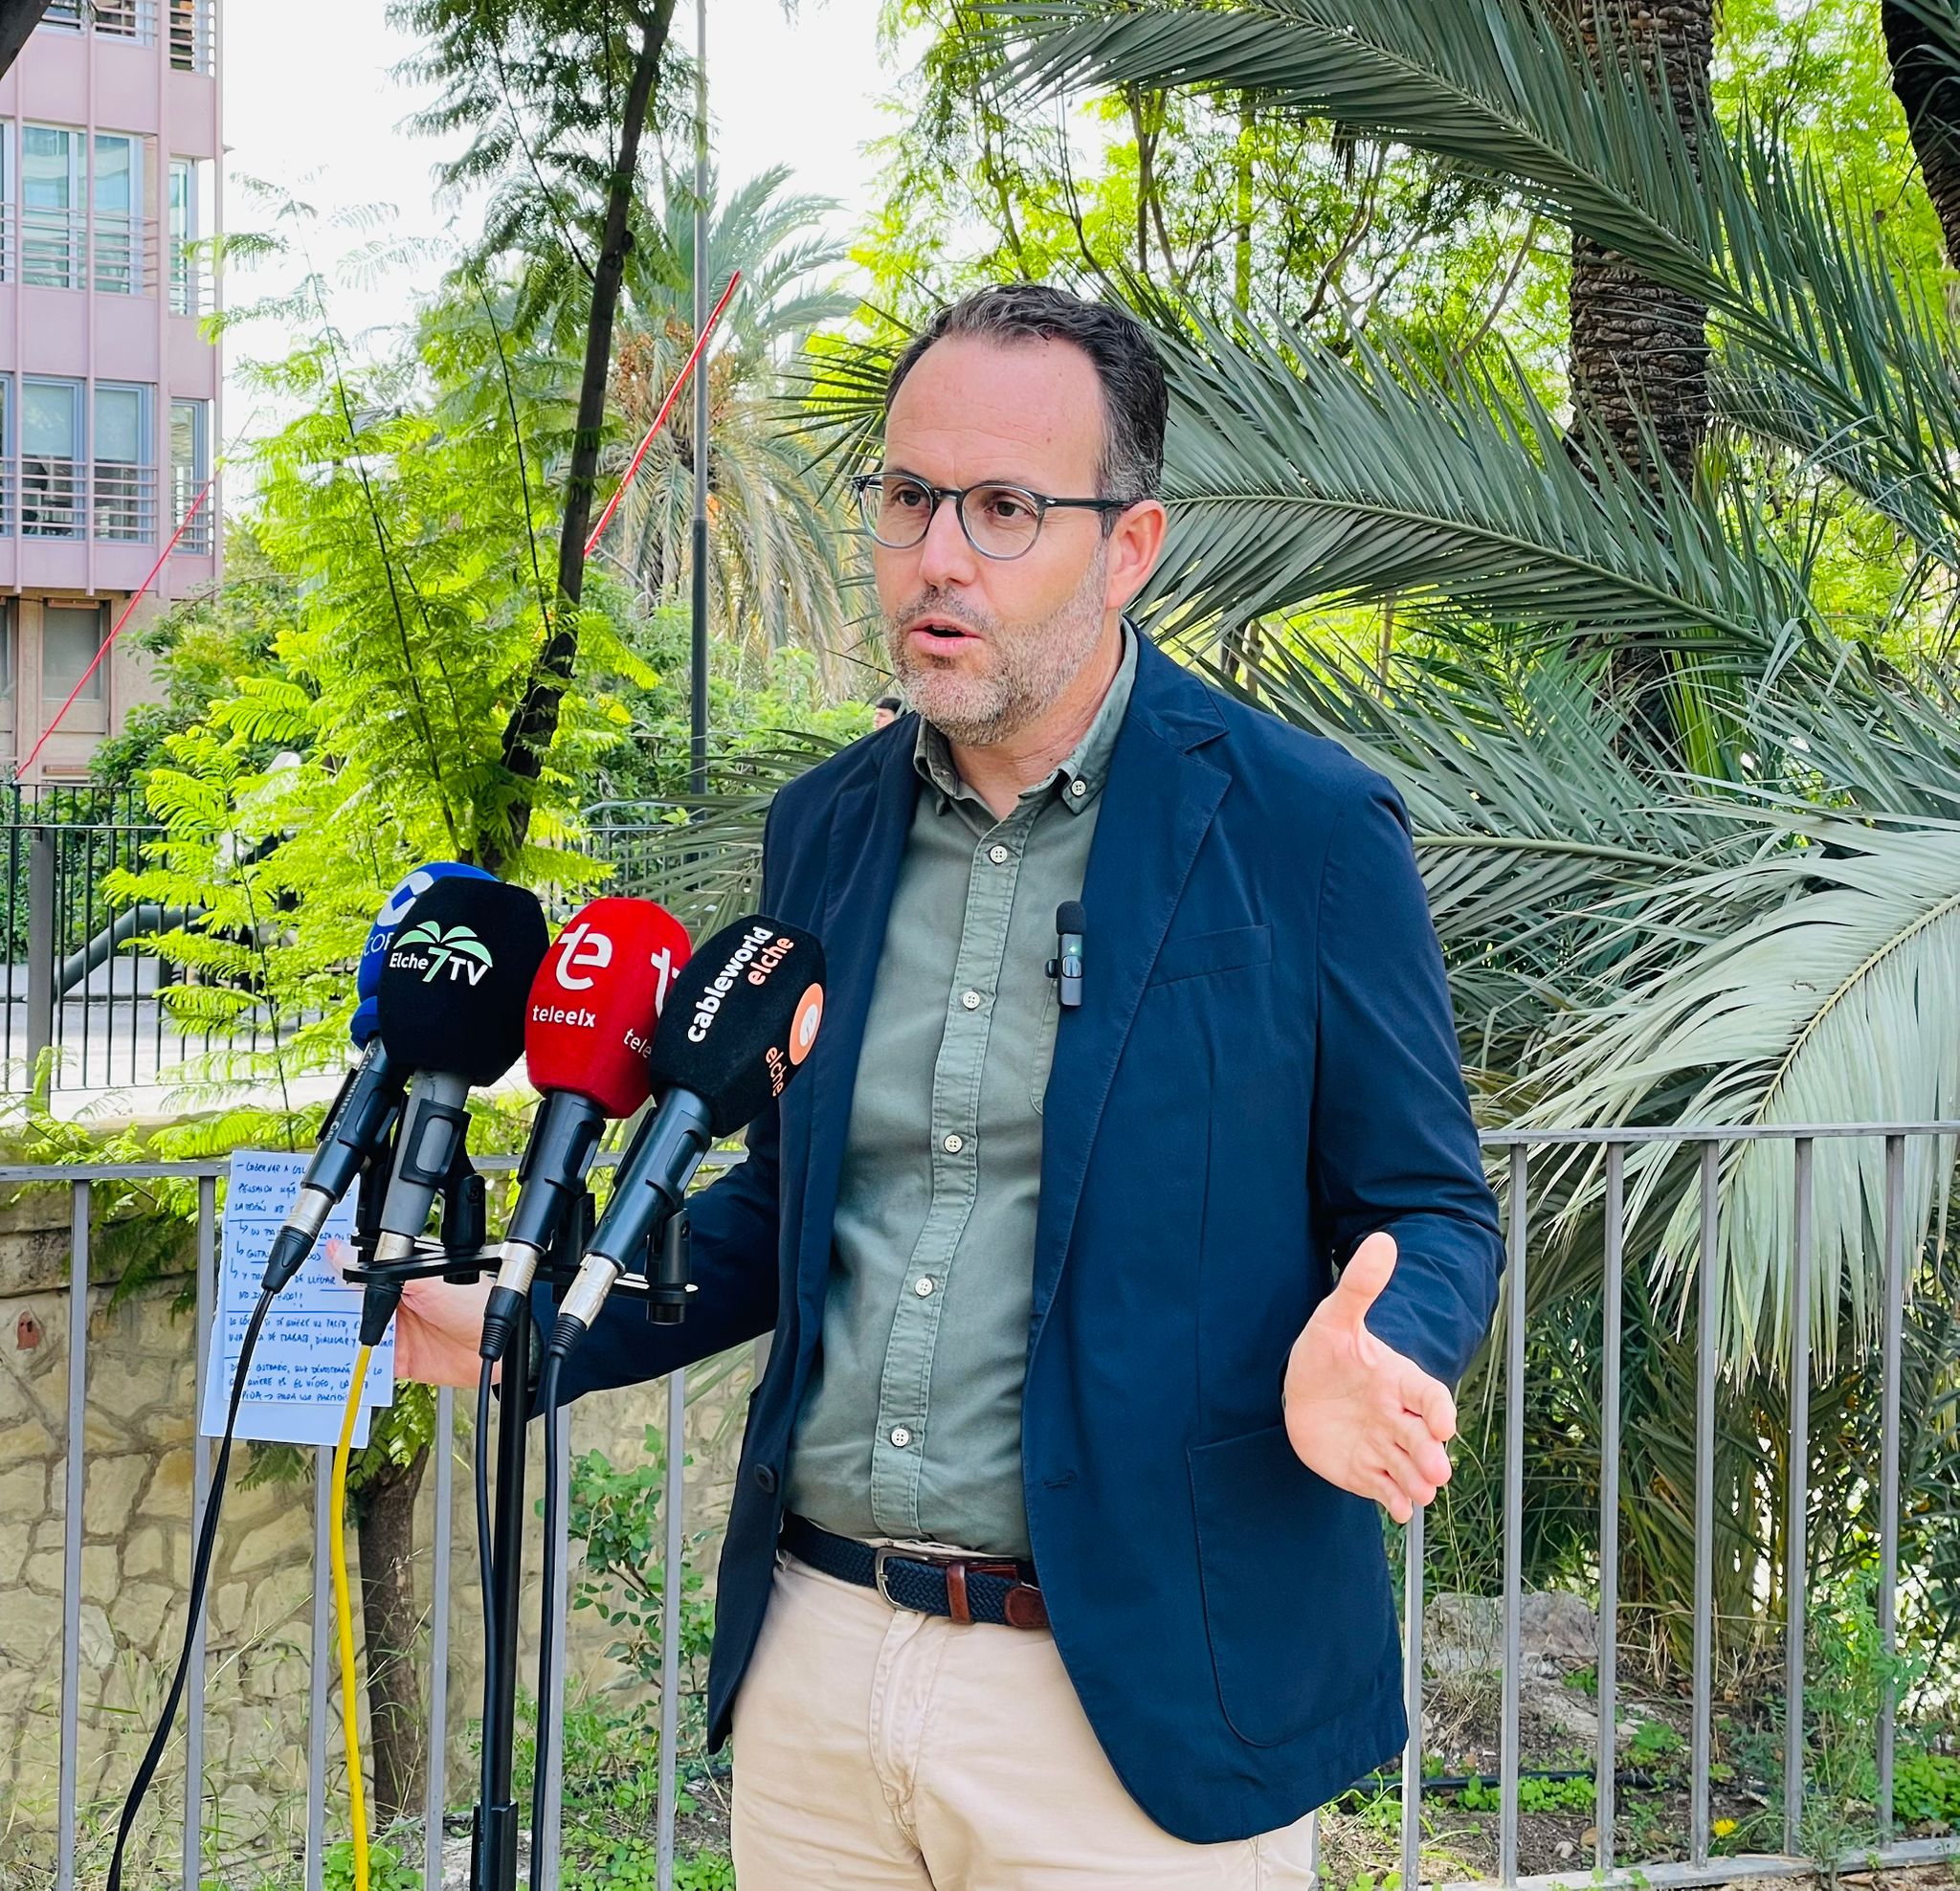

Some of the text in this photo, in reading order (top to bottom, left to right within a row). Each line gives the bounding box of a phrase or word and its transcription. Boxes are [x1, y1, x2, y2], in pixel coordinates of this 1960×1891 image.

[389, 951, 430, 970] Elche
[448, 956, 489, 987] TV
[746, 936, 794, 987] elche
[687, 925, 774, 1043] cableworld
[532, 1005, 596, 1028] teleelx
[623, 1028, 652, 1058] tele
[765, 1046, 786, 1098] elche
